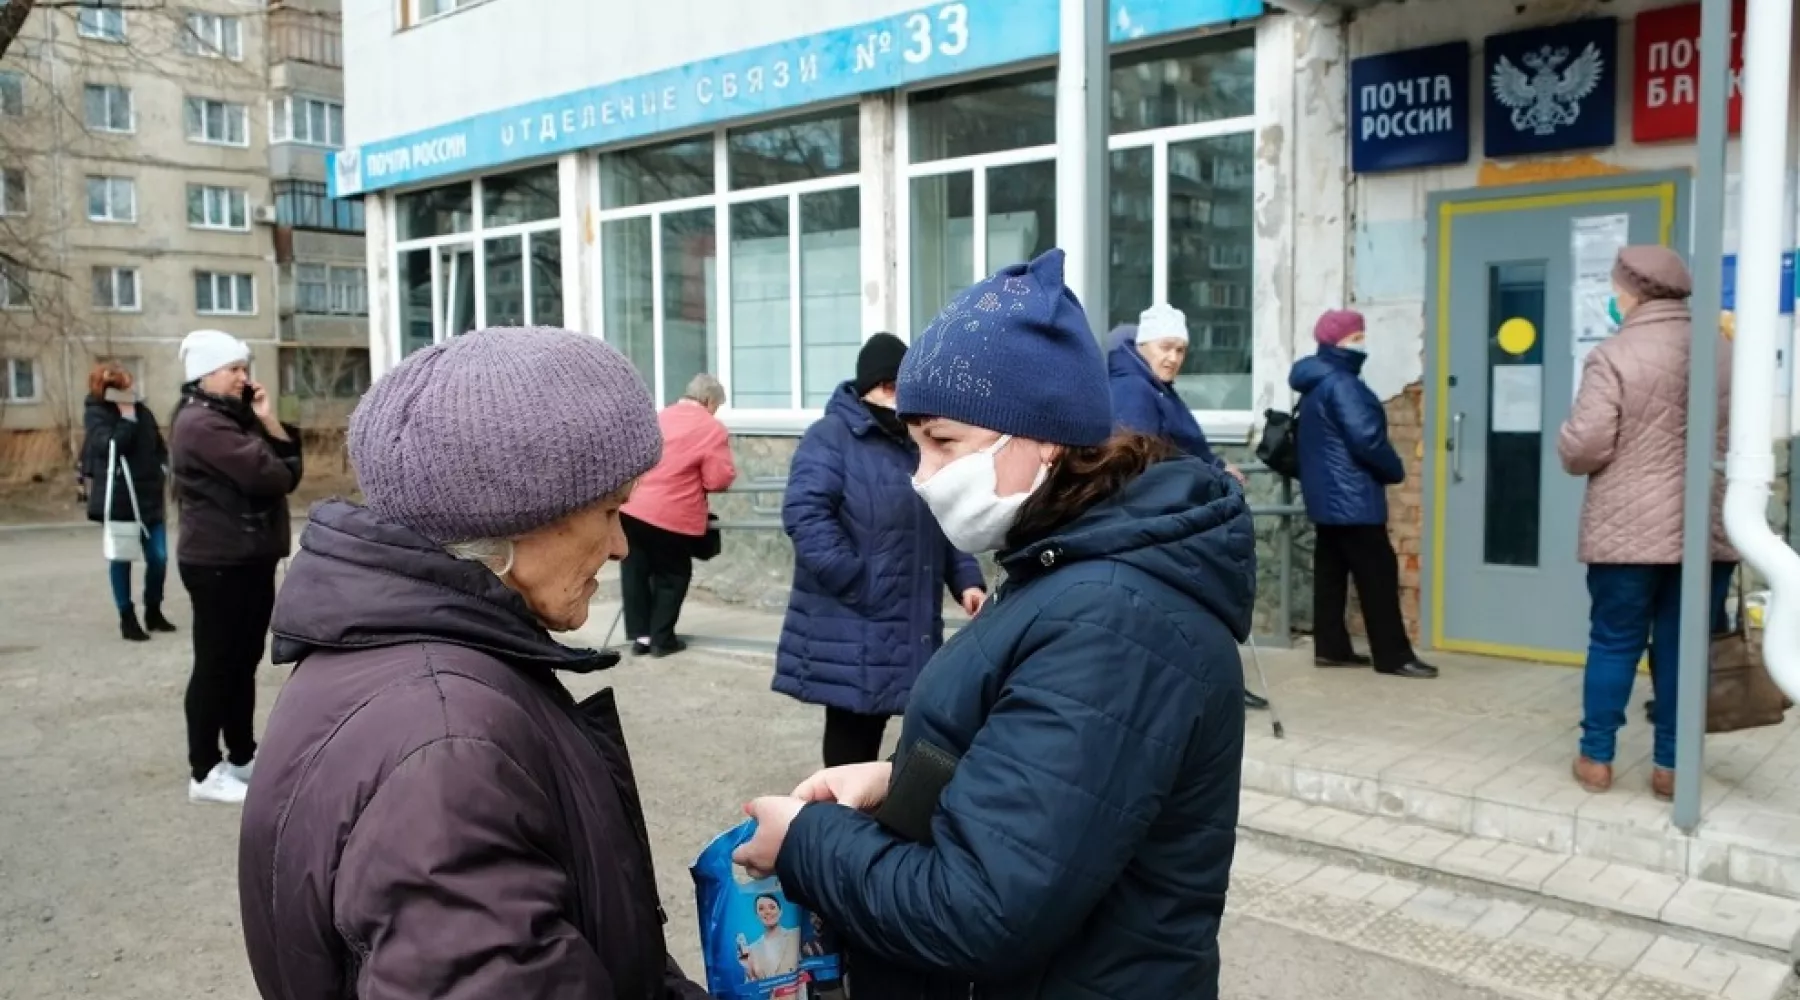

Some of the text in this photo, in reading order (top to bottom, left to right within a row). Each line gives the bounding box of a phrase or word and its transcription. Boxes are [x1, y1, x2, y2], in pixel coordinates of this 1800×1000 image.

[501, 3, 969, 147] ОТДЕЛЕНИЕ СВЯЗИ № 33
[1361, 74, 1452, 113] ПОЧТА
[1647, 68, 1745, 108] БАК
[1362, 105, 1453, 141] РОССИИ
